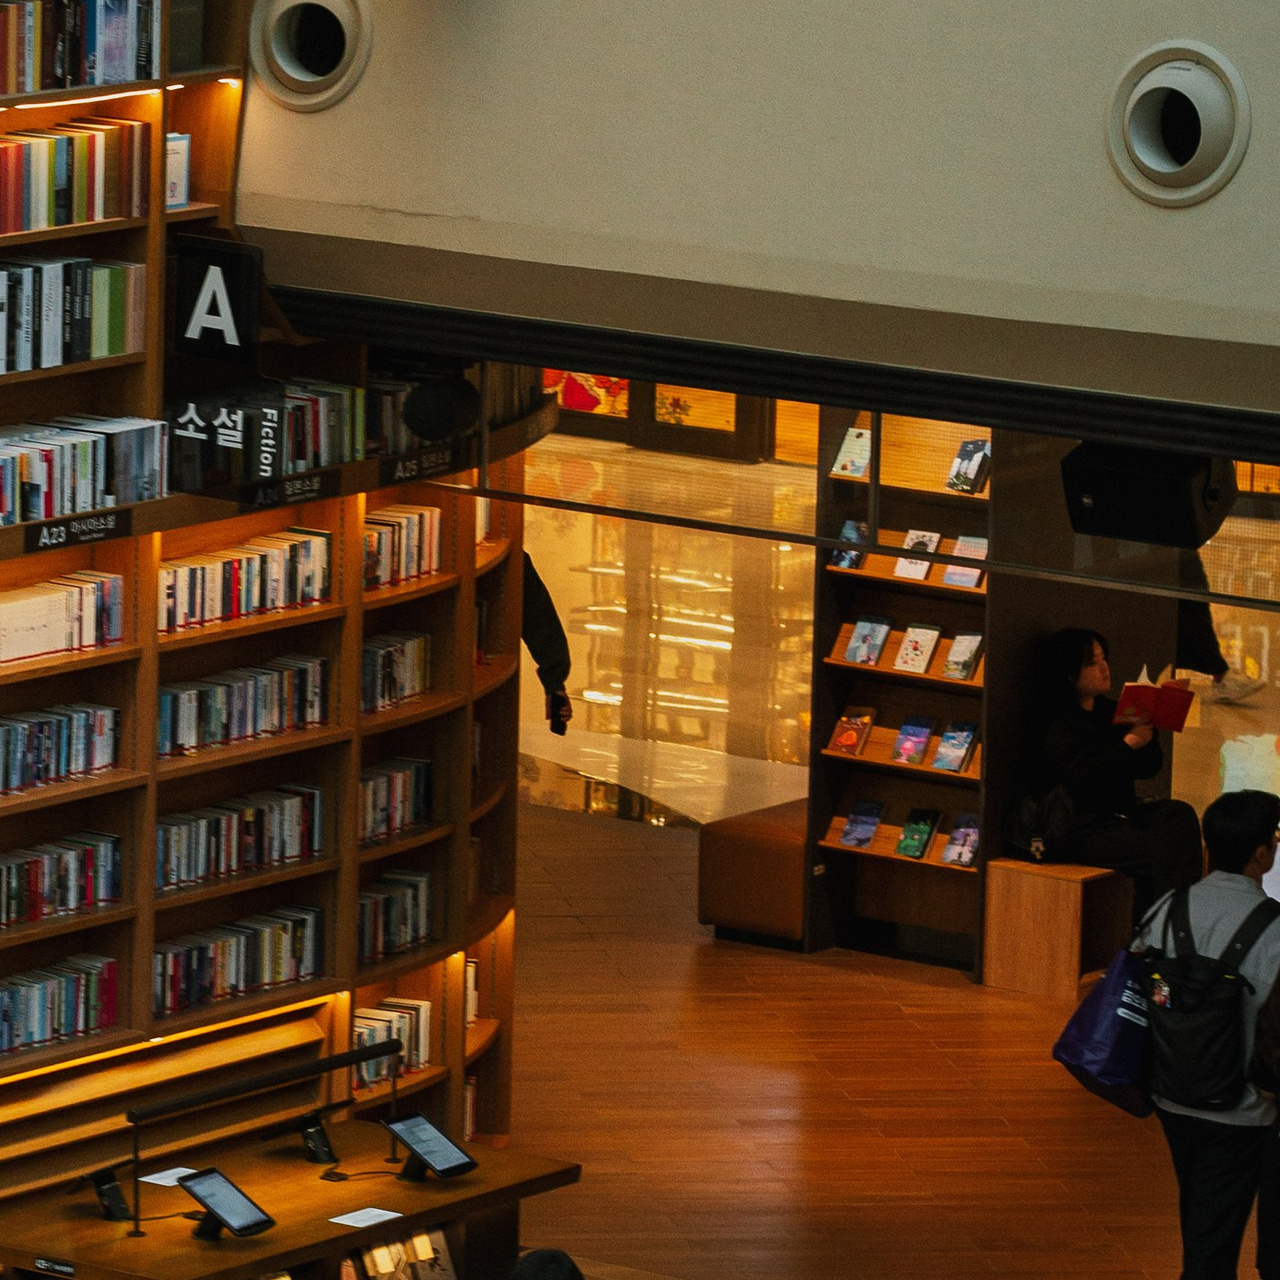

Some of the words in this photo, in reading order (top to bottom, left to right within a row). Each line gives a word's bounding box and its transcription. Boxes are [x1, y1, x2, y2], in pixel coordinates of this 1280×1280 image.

[184, 265, 240, 347] A
[175, 402, 244, 450] 소설
[259, 407, 278, 478] Fiction
[38, 526, 66, 547] A23
